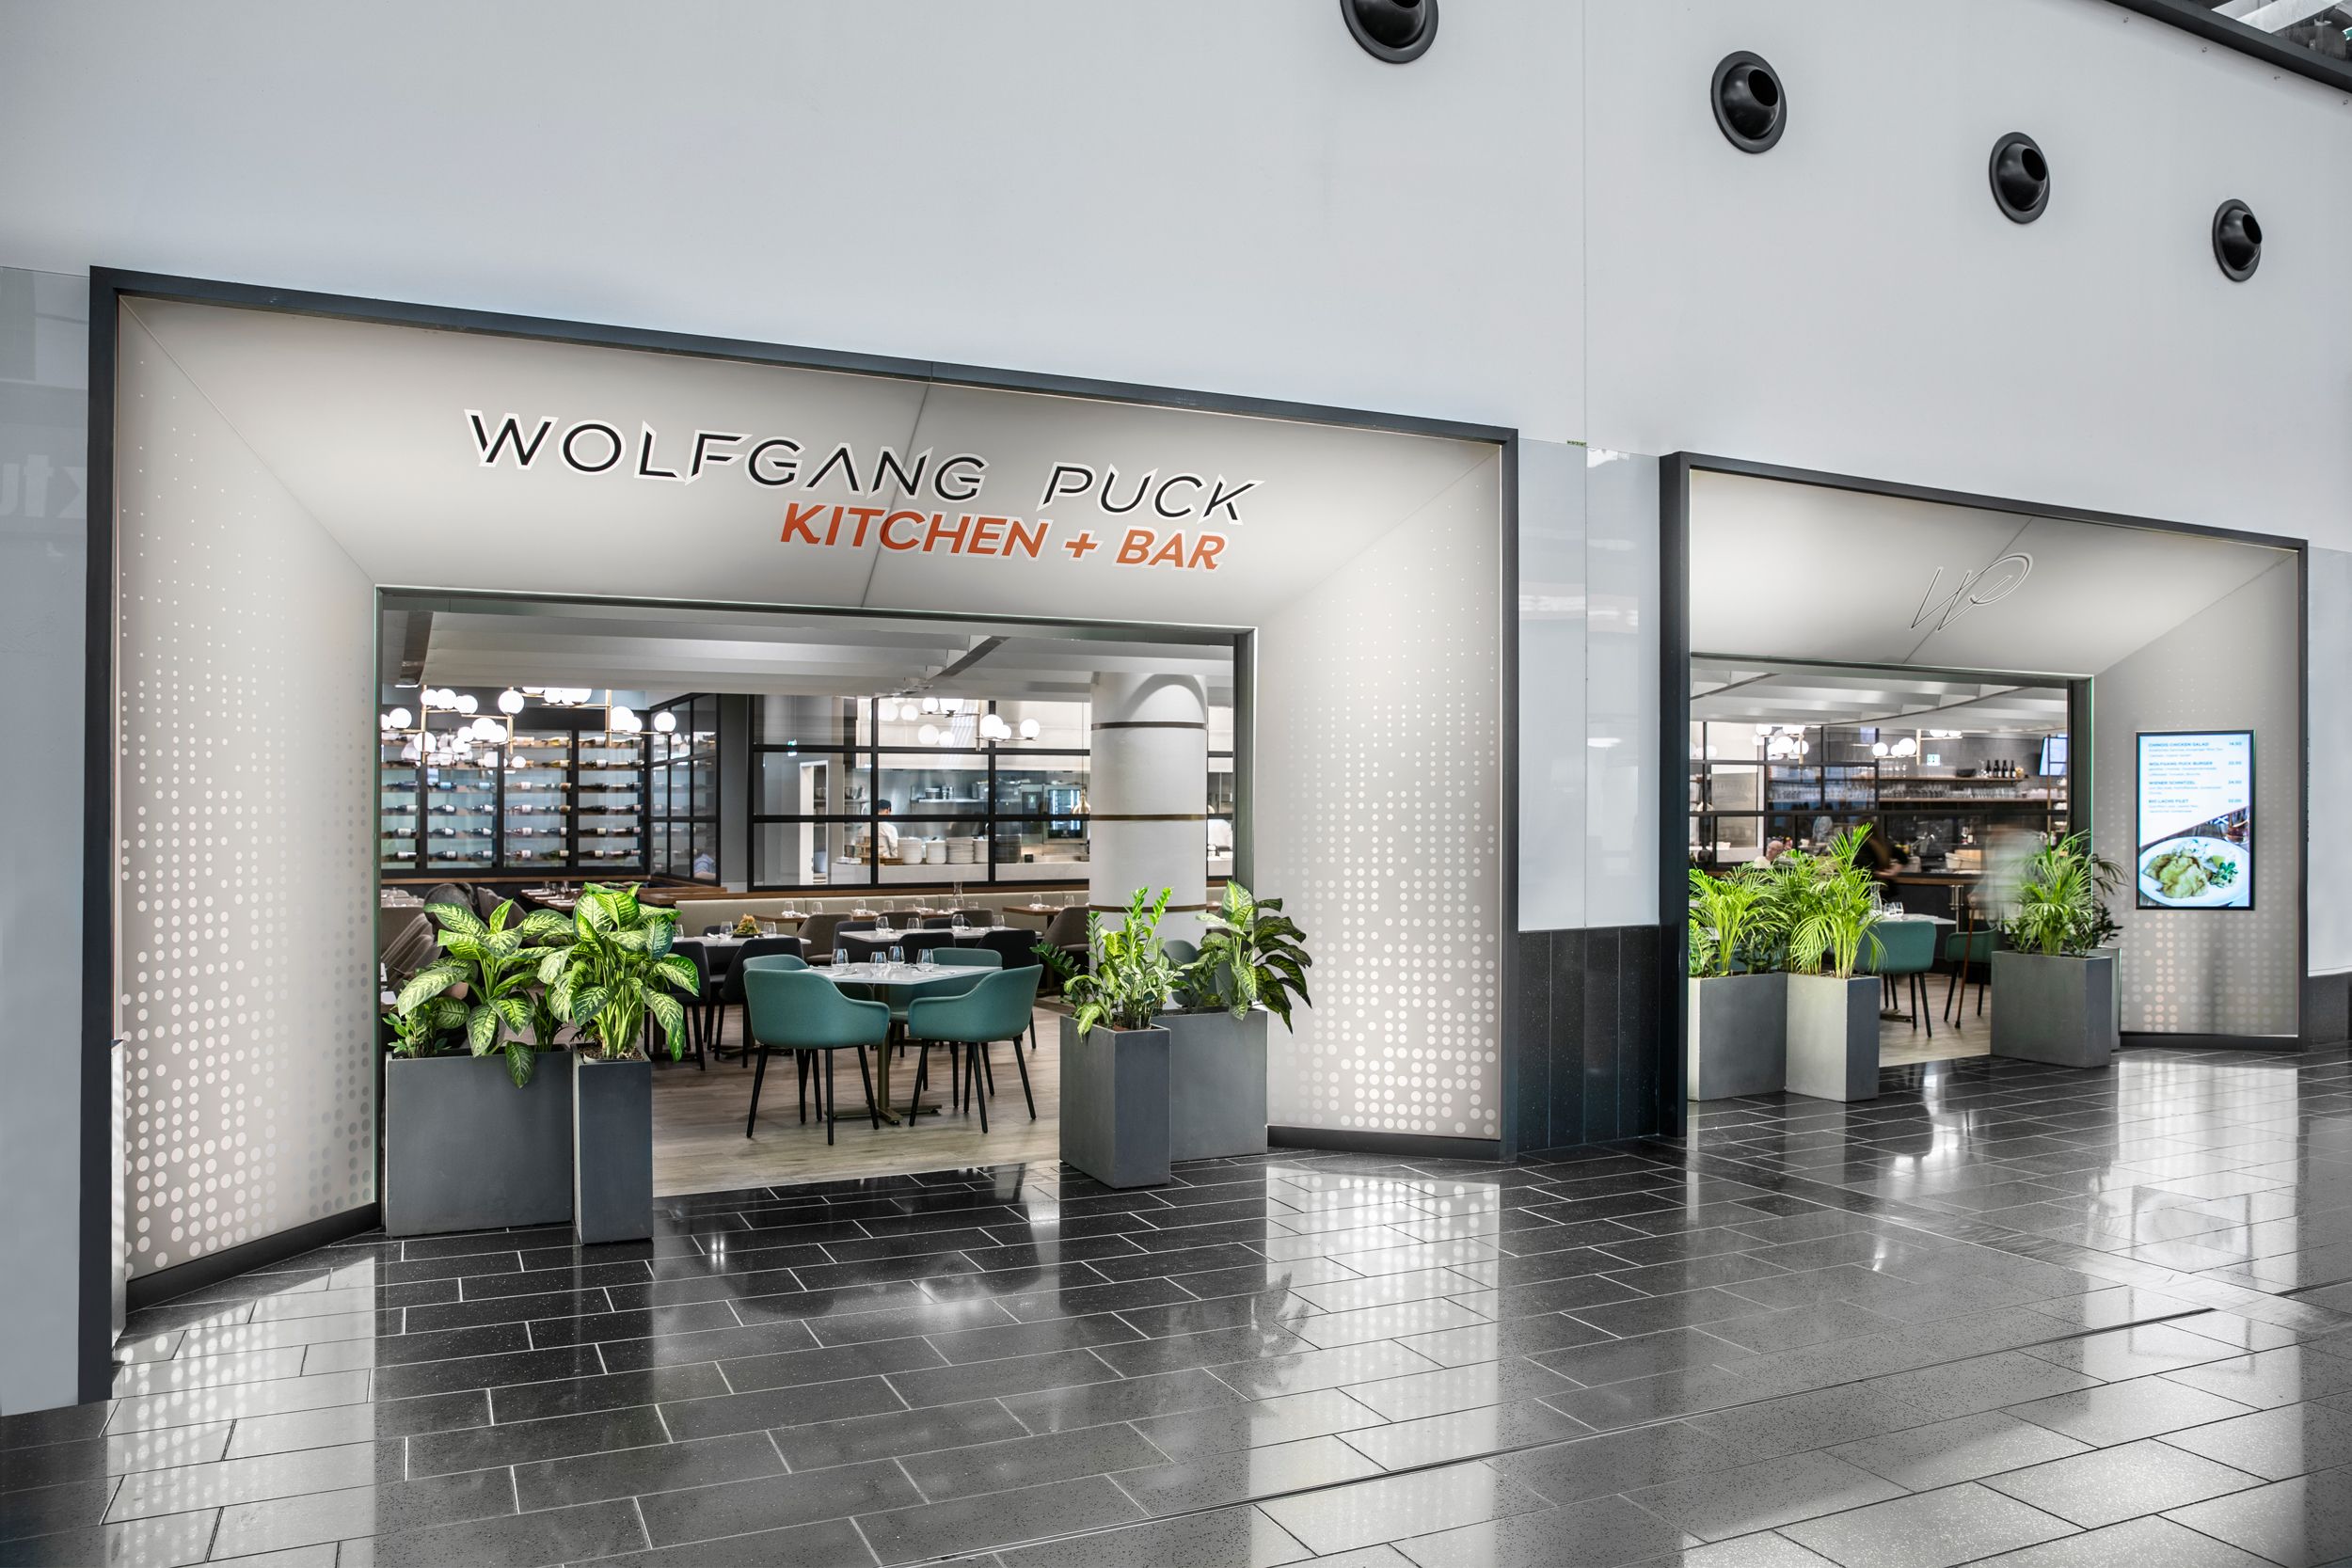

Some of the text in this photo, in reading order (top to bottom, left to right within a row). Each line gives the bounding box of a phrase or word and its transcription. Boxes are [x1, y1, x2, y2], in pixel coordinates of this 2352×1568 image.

[467, 411, 1263, 525] WOLFGANG PUCK
[780, 502, 1226, 570] KITCHEN + BAR
